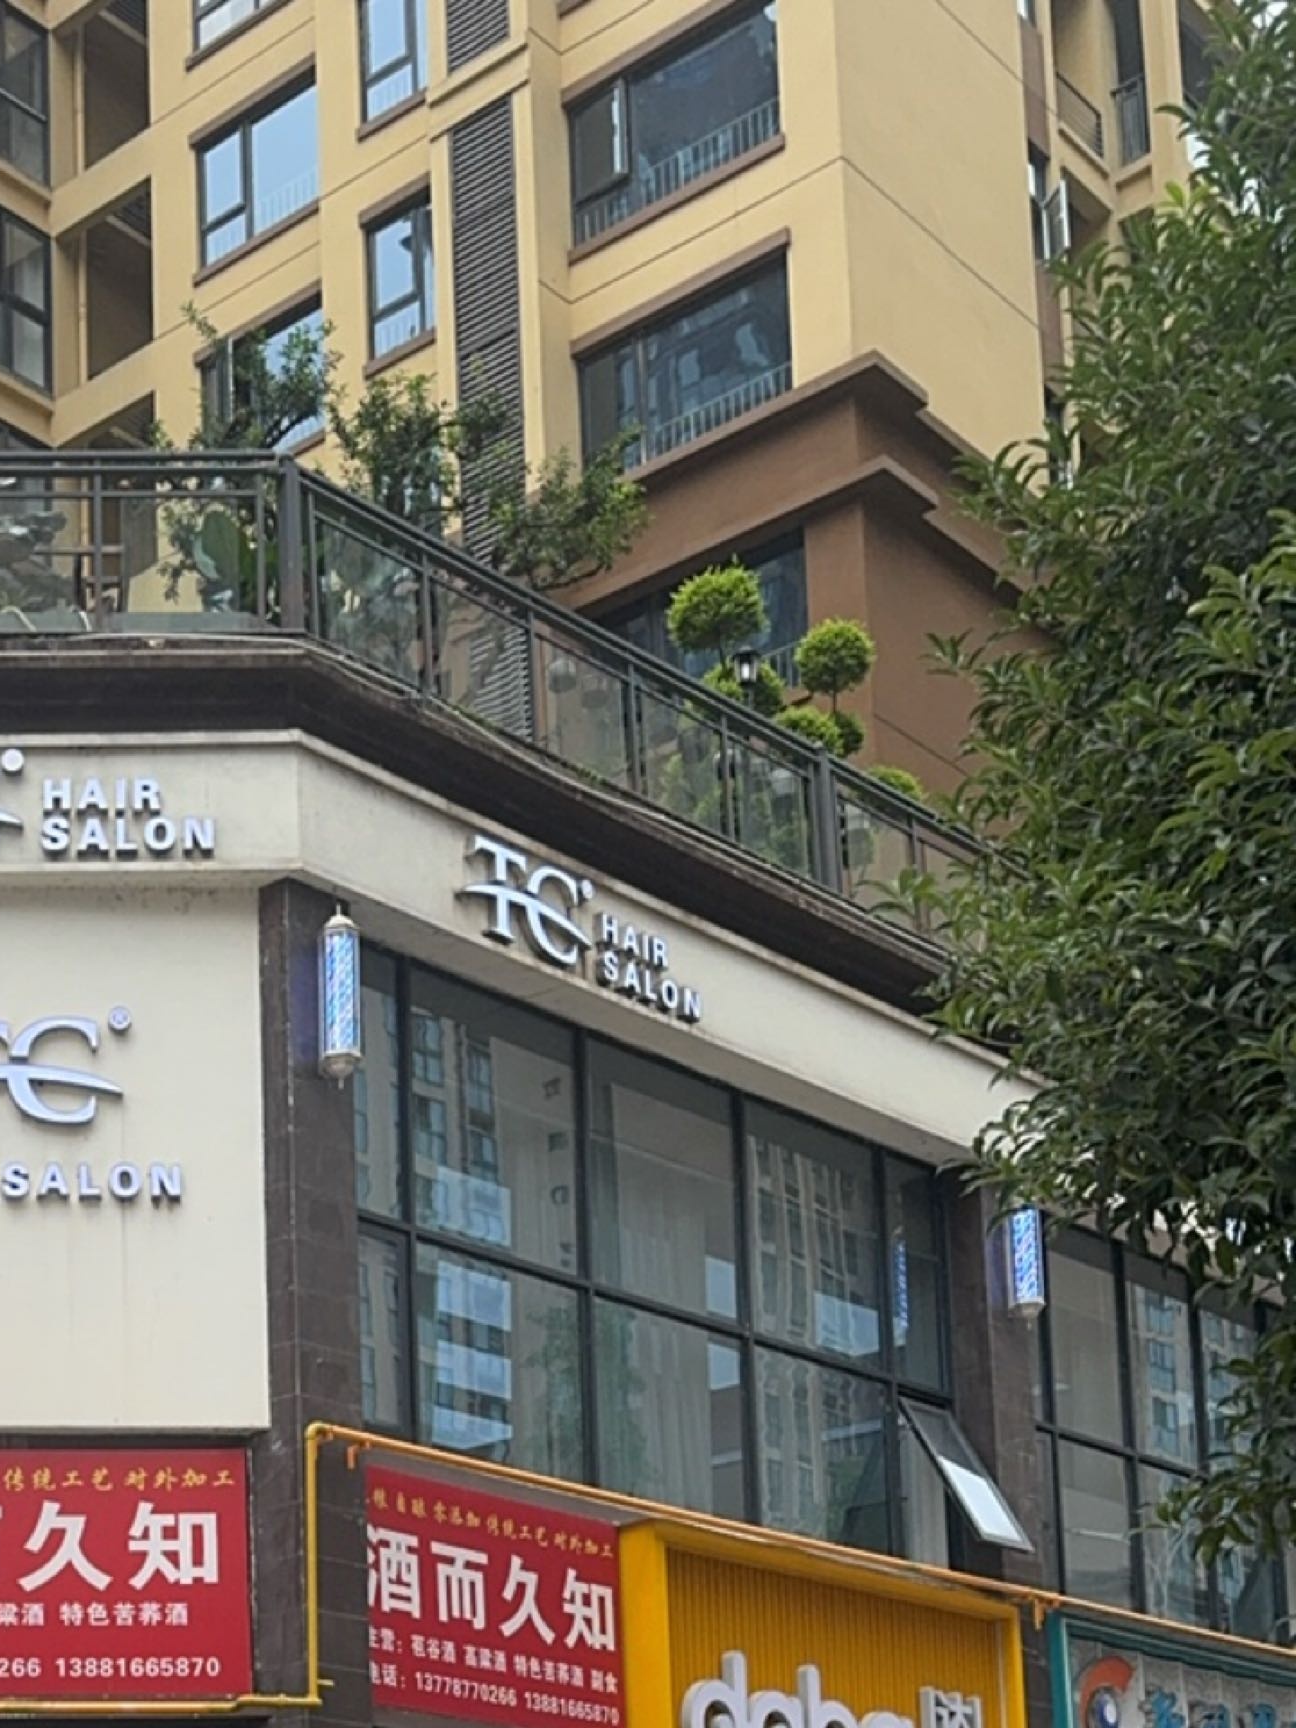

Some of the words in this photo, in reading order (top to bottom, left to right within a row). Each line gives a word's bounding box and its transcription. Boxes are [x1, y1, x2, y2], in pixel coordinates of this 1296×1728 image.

[42, 777, 163, 815] HAIR
[41, 815, 215, 859] SALON
[597, 911, 668, 970] HAIR
[597, 950, 702, 1023] SALON
[1, 1160, 183, 1205] SALON
[366, 1522, 616, 1653] 酒而久知
[55, 1656, 221, 1678] 13881665870
